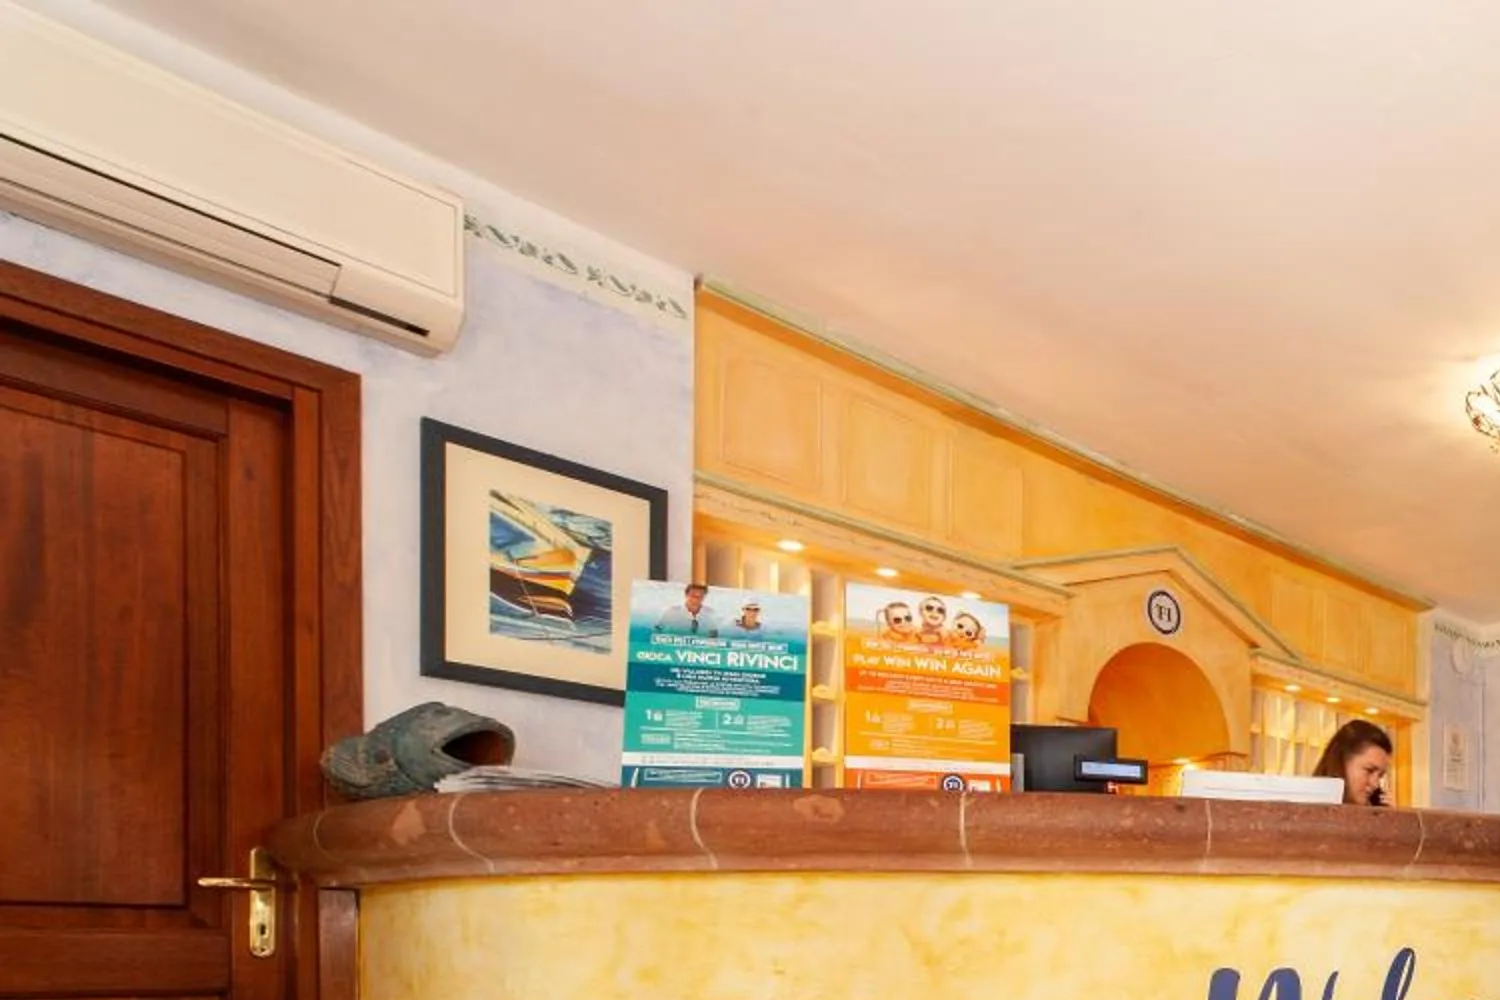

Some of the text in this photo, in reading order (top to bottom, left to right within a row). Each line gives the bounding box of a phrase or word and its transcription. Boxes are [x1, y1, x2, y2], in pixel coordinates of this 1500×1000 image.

[636, 650, 798, 671] GIOCA VINCI RIVINCI
[851, 654, 1002, 679] PLAY WIN WIN AGAIN
